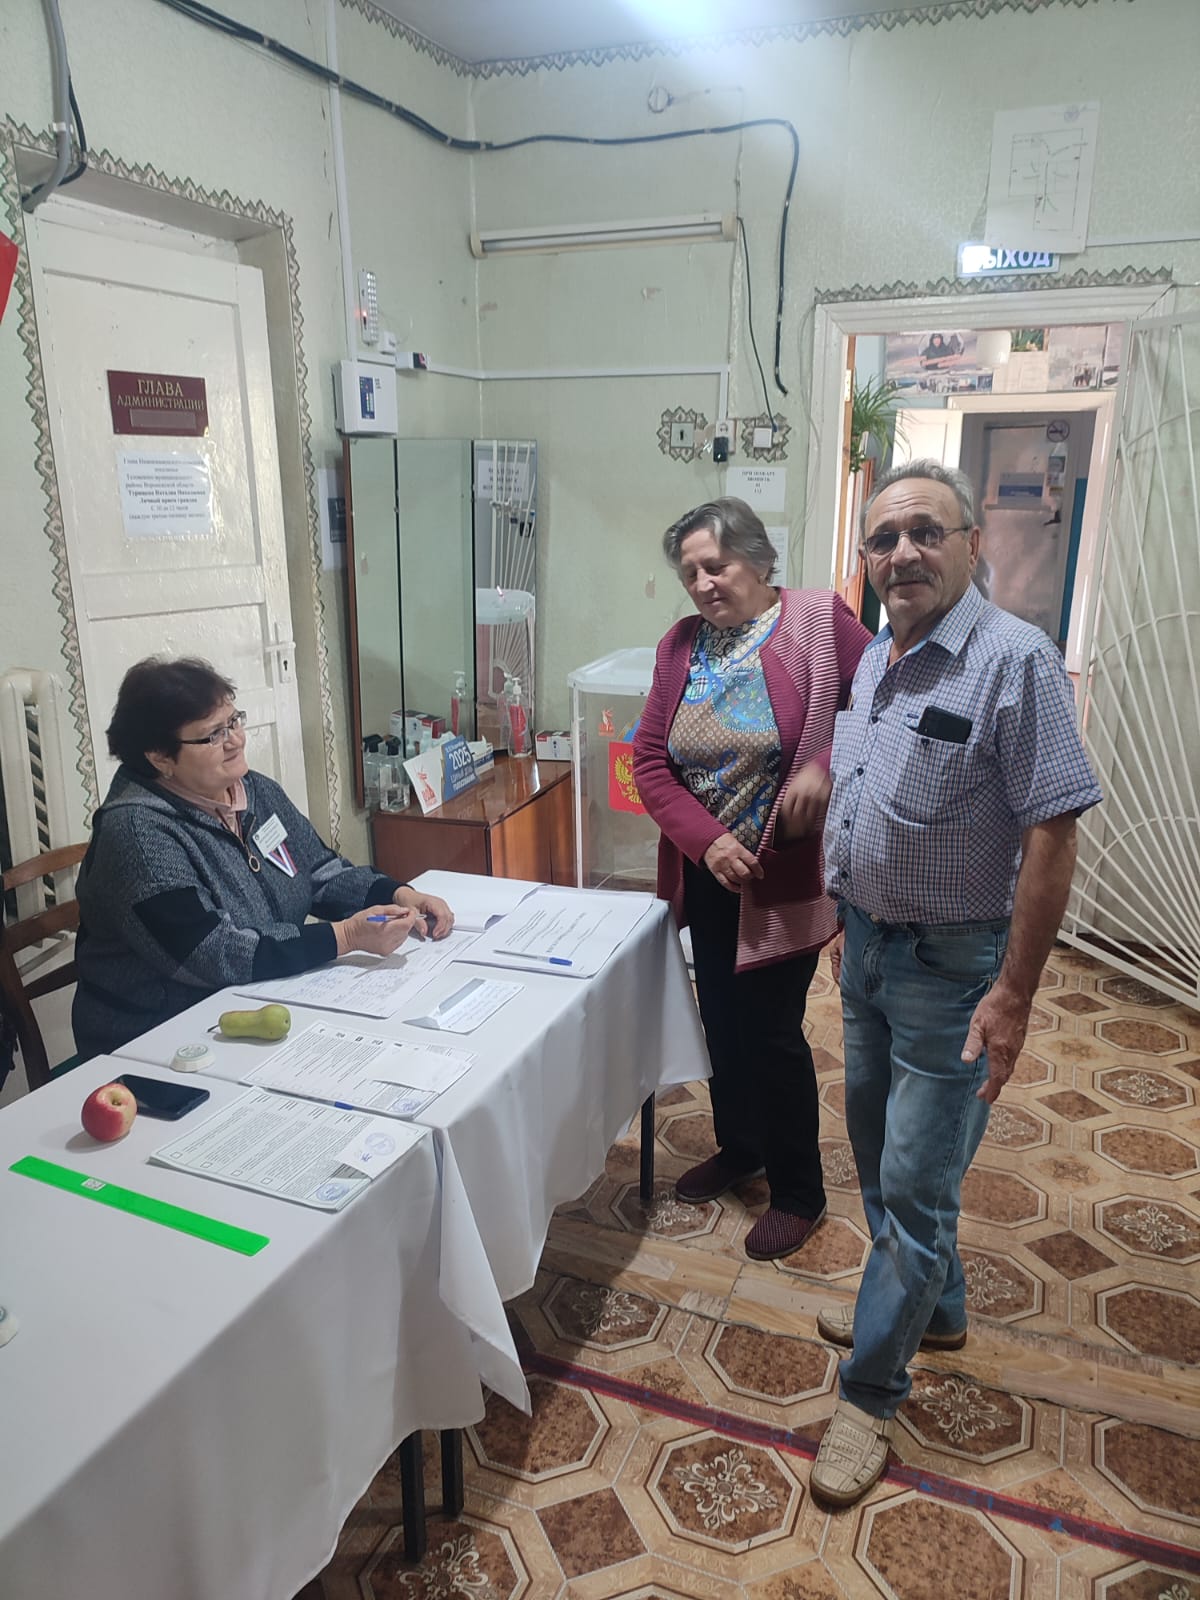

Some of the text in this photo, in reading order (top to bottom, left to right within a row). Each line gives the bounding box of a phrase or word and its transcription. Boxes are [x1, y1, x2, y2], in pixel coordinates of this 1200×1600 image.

[137, 379, 184, 397] ГЛАВА
[117, 395, 205, 410] АДМИНИСТРАЦИИ
[448, 746, 472, 771] 2025
